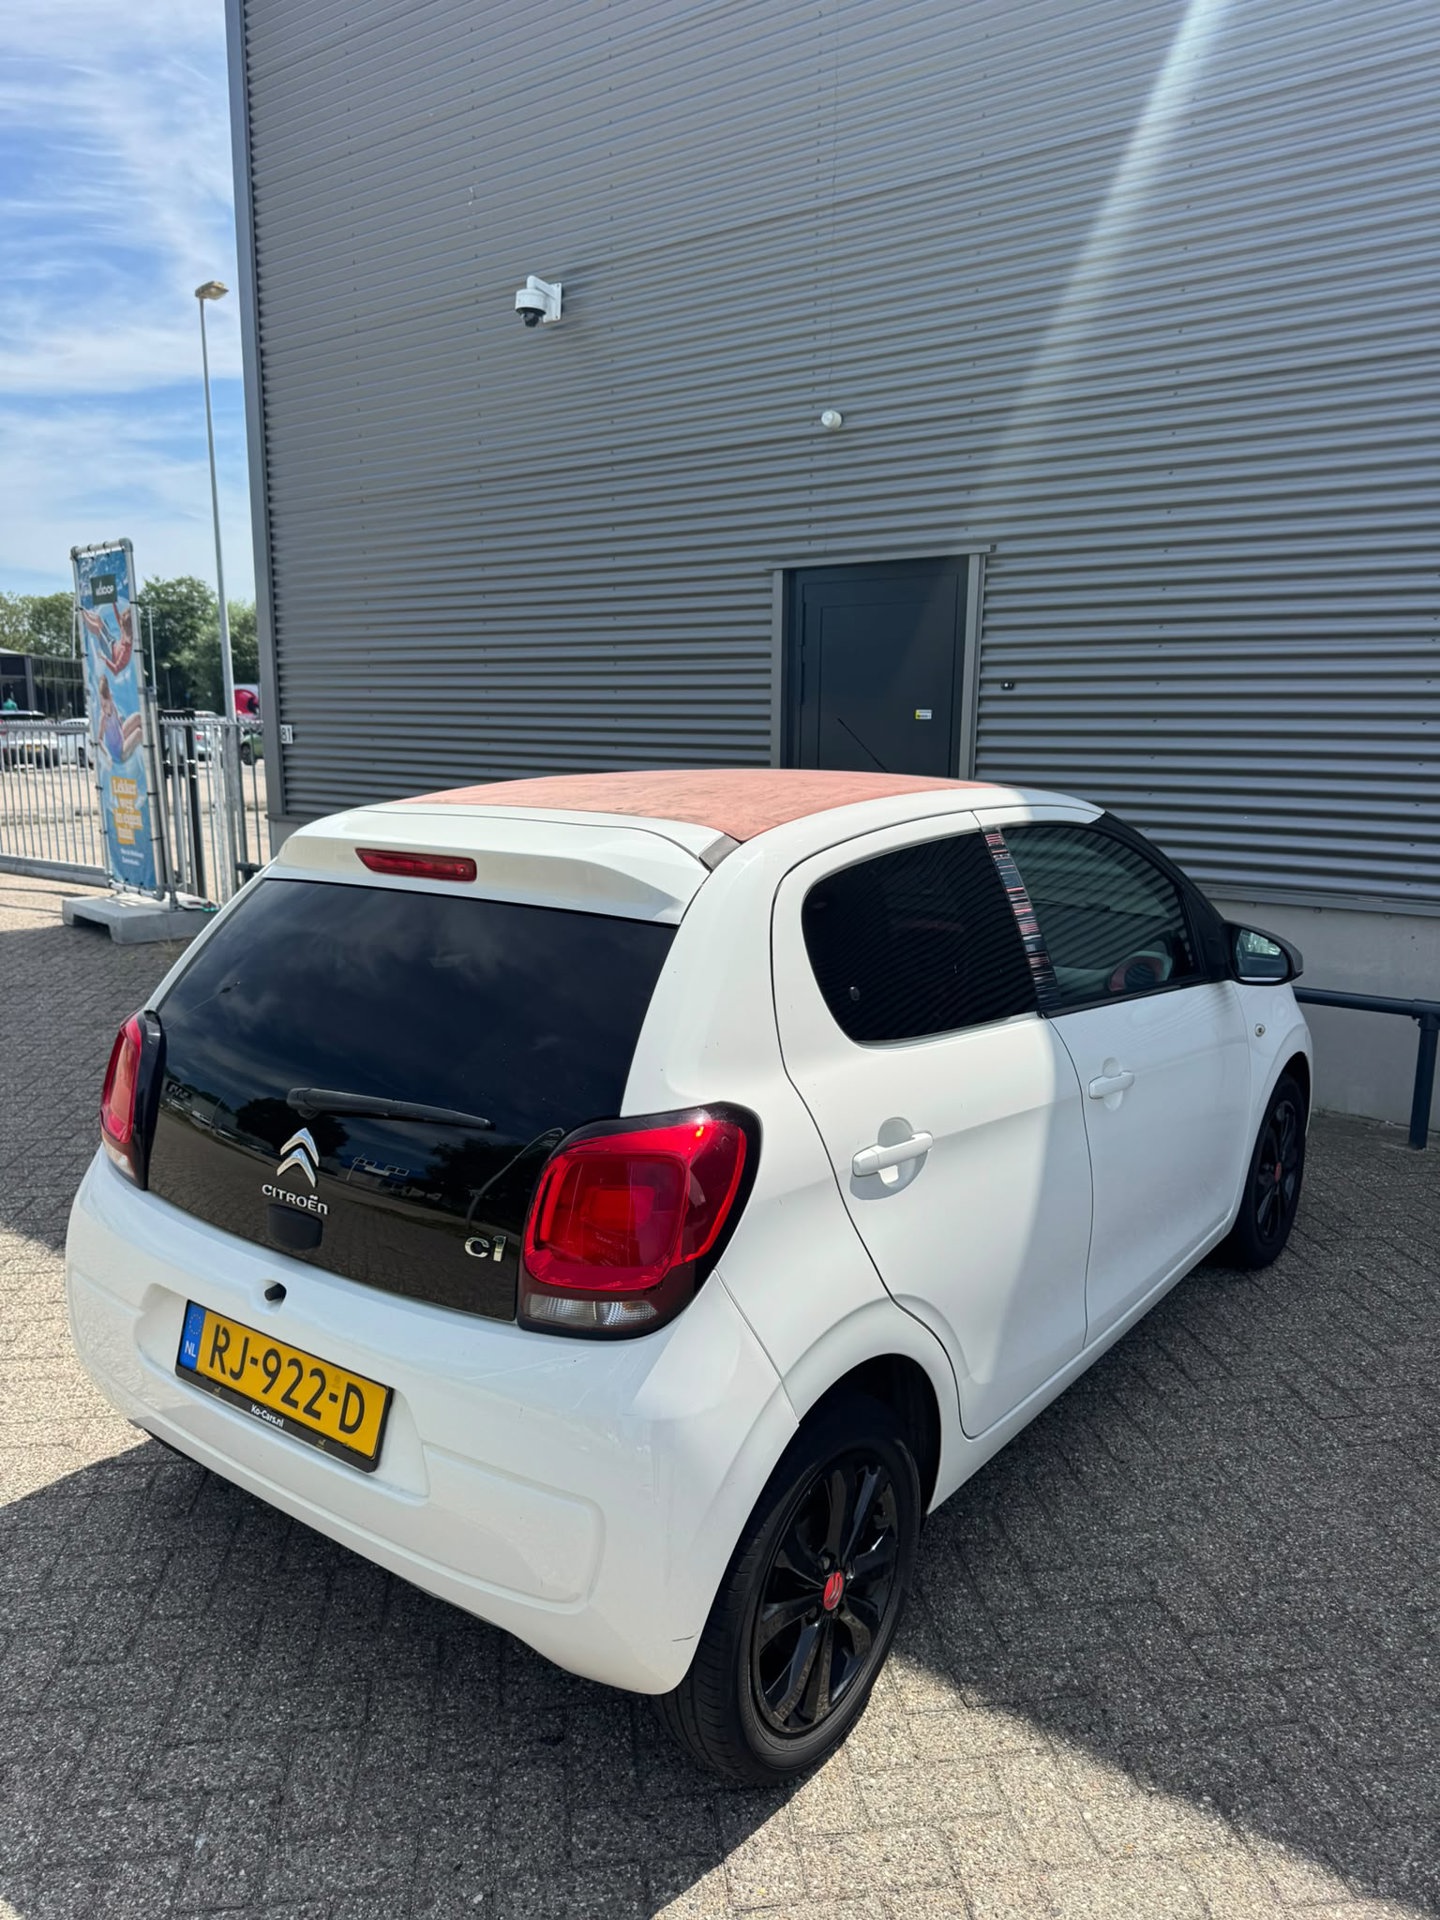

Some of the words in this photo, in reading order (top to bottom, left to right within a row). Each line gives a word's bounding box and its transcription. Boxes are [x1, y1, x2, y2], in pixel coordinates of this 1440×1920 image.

[261, 1184, 328, 1215] CITROËN
[464, 1235, 507, 1262] C1
[184, 1340, 196, 1358] NL
[208, 1323, 365, 1434] RJ-922-D
[251, 1404, 284, 1428] Ko-Cars.nl
